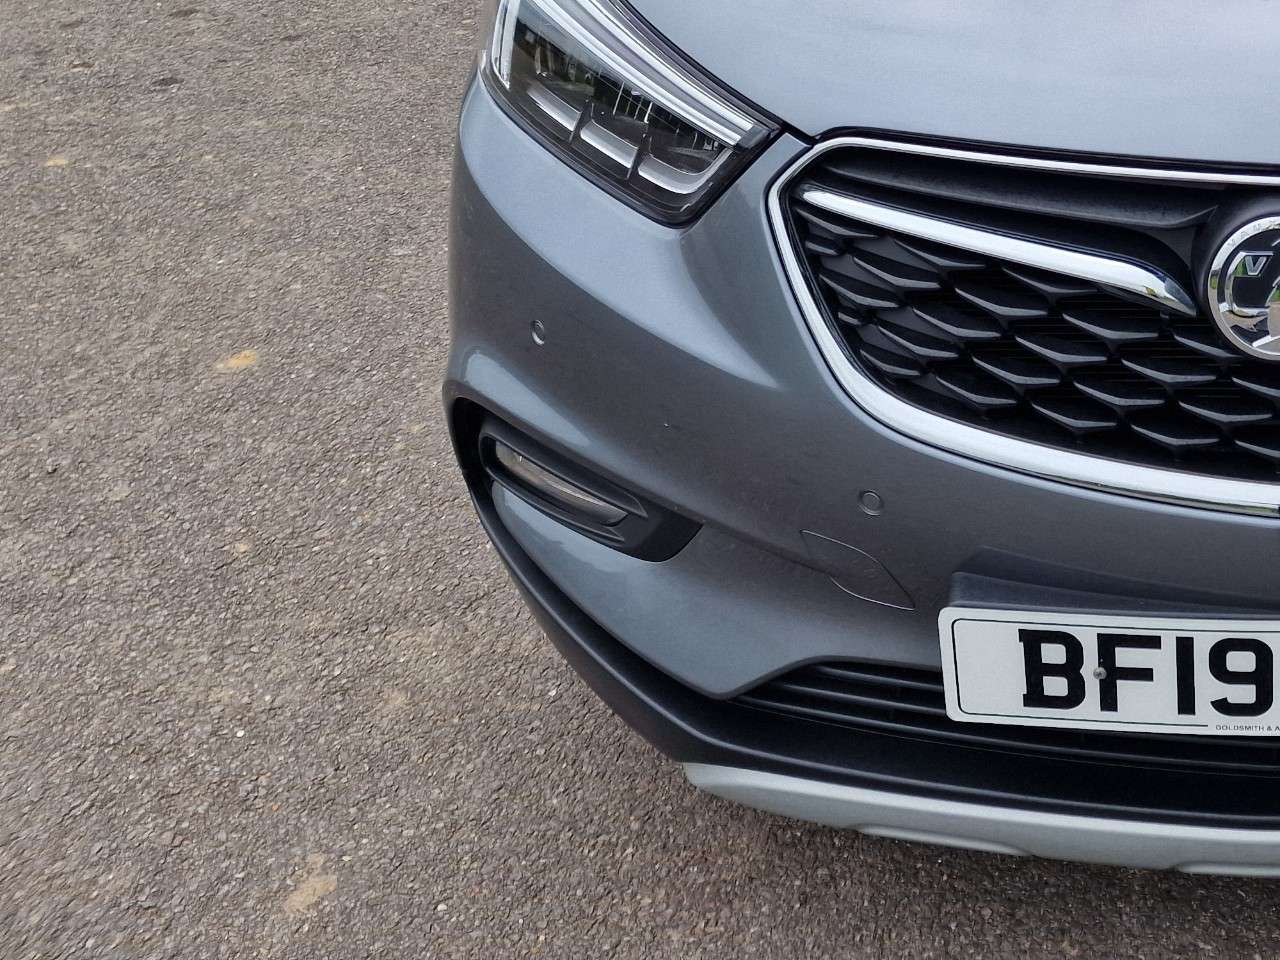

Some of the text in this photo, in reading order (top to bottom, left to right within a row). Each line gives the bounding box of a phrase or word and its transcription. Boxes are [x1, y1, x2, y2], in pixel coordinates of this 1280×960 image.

[1018, 628, 1274, 717] BF19
[1215, 724, 1264, 732] GOLDSMITH
[1266, 724, 1273, 732] &
